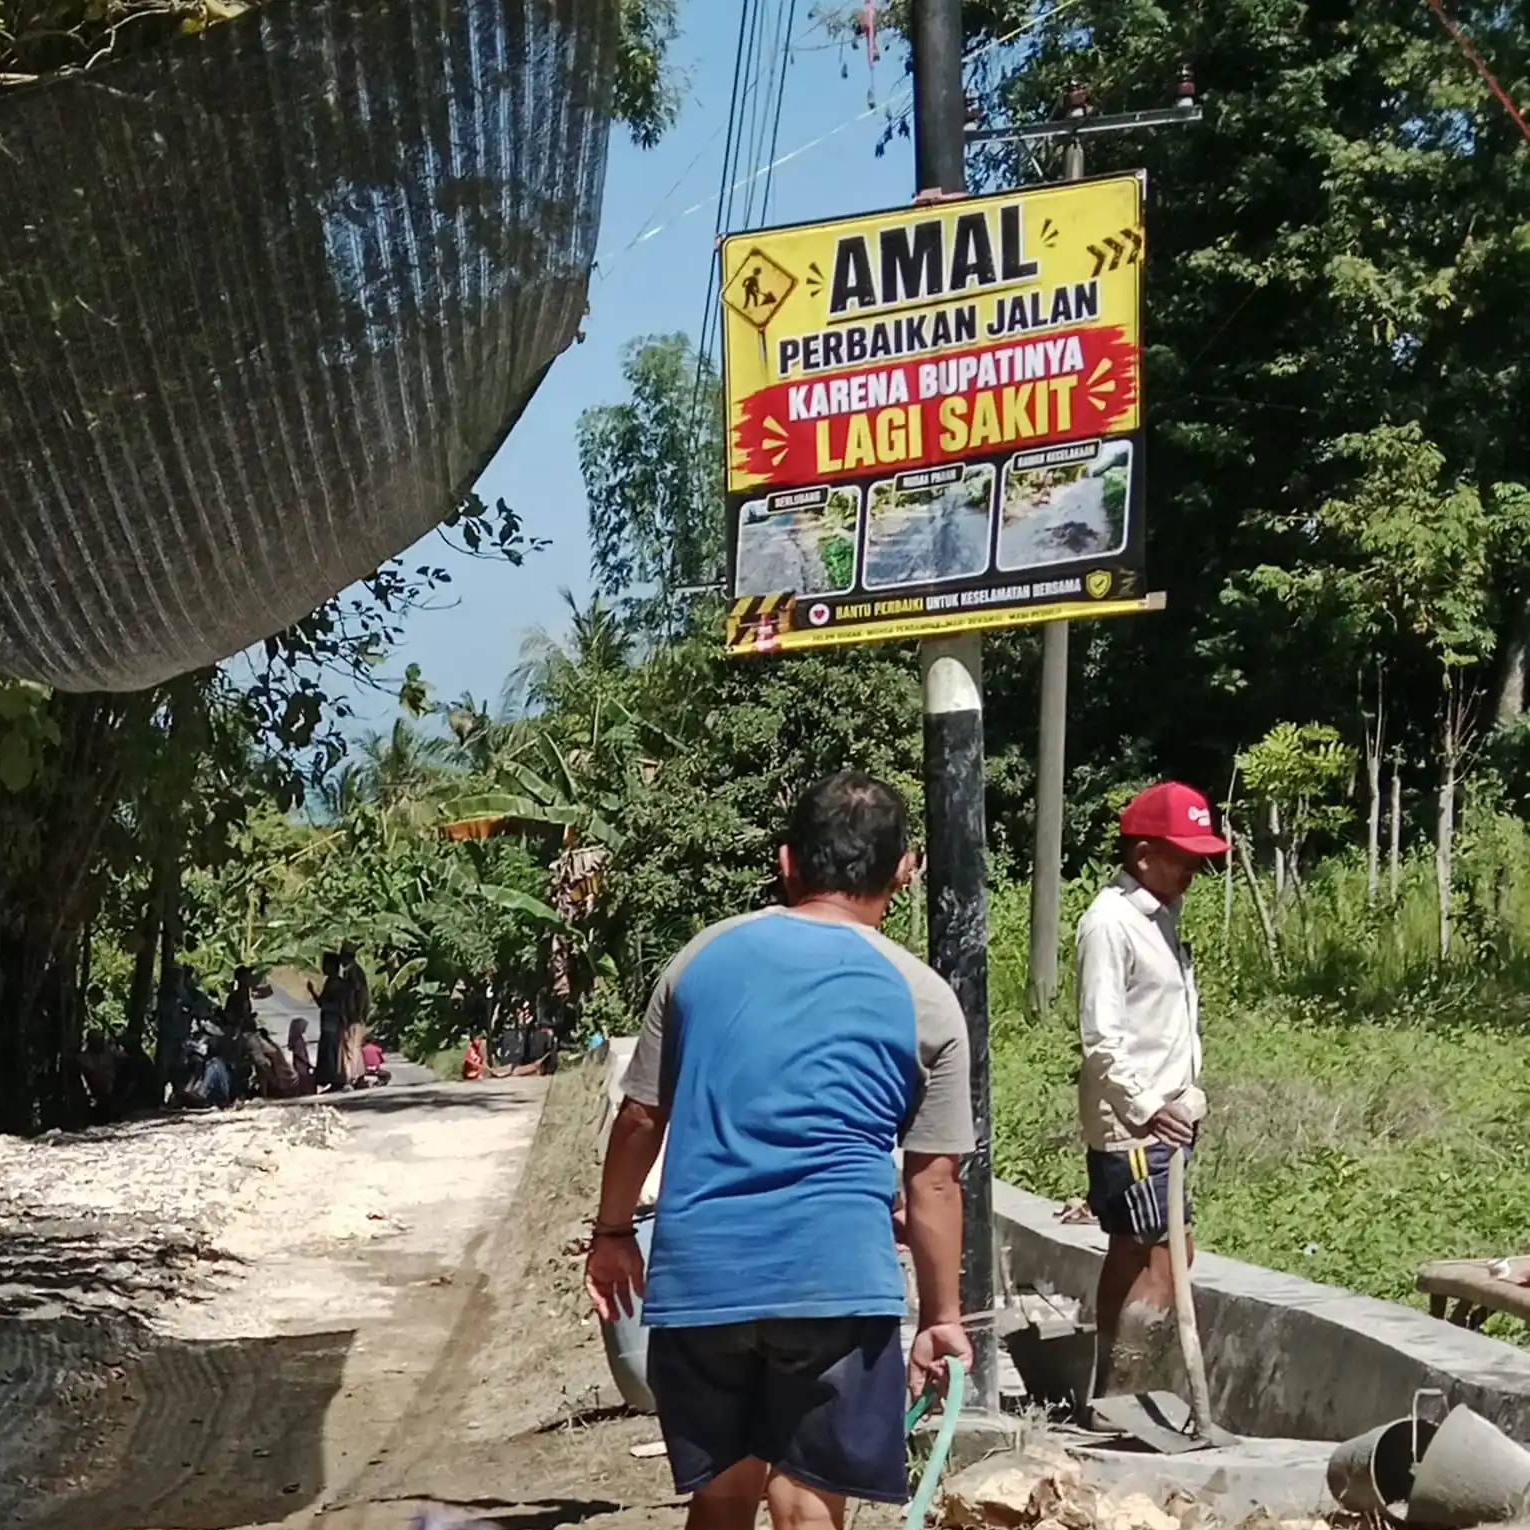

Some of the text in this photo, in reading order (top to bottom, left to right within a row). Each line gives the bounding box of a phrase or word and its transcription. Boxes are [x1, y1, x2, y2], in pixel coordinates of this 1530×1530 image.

[829, 204, 1039, 314] AMAL
[778, 281, 1098, 375] PERBAIKAN JALAN
[788, 336, 1084, 421] KARENA BUPATINYA
[815, 376, 1078, 475] LAGI SAKIT
[835, 577, 1082, 620] BANTU PERBAIKI UNTUK KESELAMATAN BERSAMA
